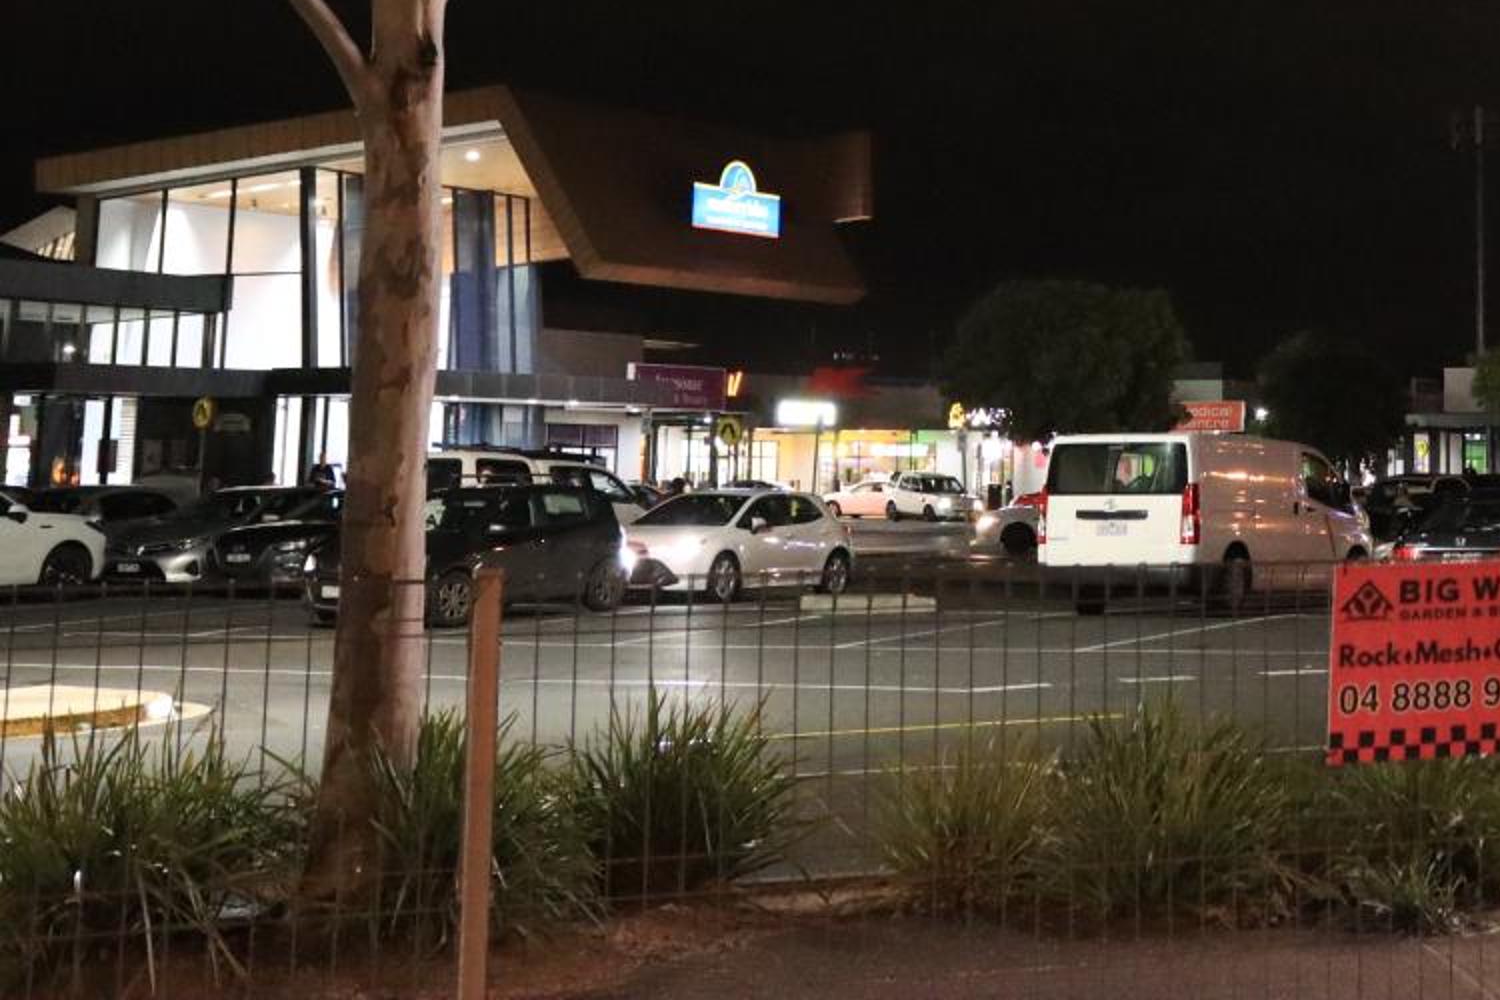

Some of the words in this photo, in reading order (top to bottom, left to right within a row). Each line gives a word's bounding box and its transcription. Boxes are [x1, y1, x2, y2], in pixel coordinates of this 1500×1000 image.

[1400, 578, 1459, 603] BIG
[1400, 606, 1467, 621] GARDEN
[1340, 684, 1379, 715] 04
[1391, 679, 1471, 712] 8888
